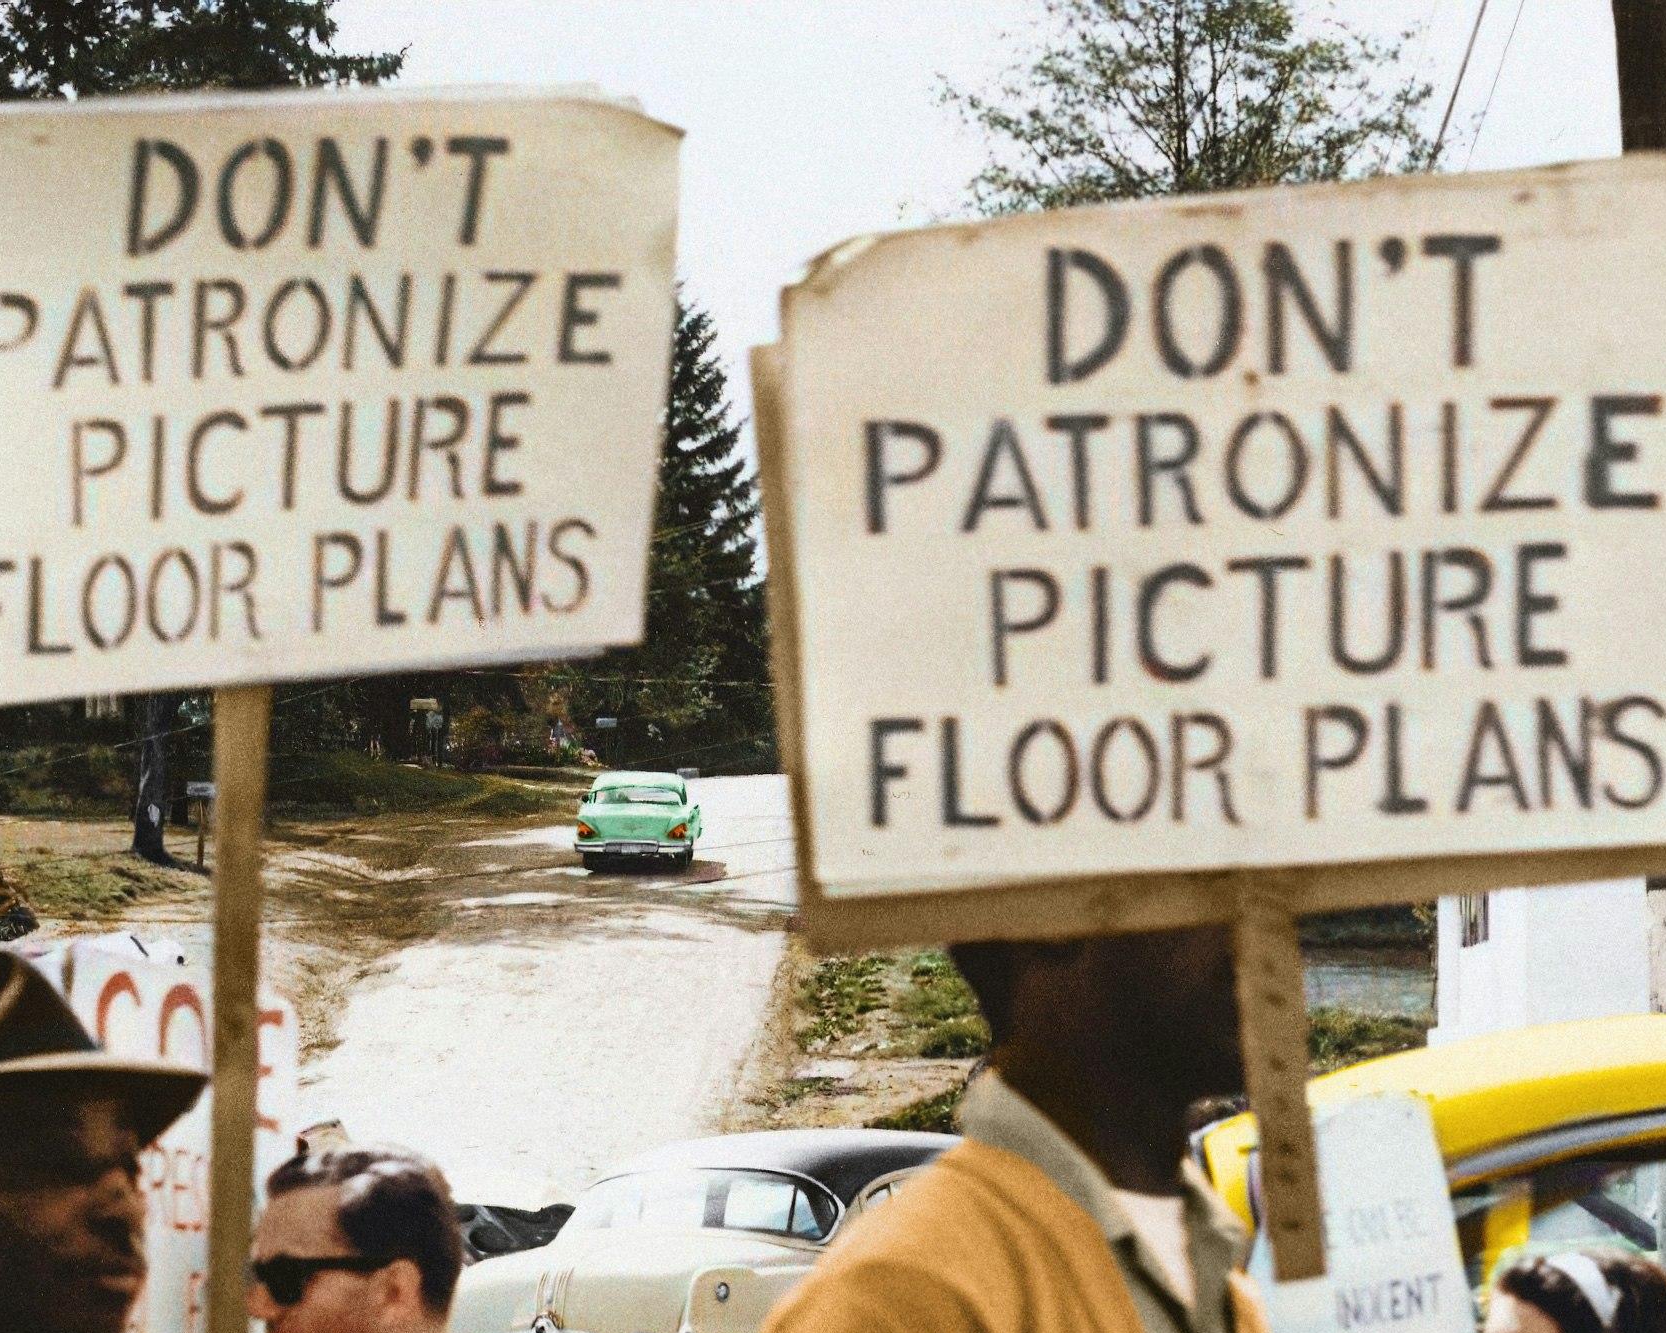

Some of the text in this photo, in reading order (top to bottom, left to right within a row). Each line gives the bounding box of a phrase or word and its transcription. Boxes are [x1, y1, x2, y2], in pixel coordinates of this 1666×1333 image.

[125, 135, 510, 257] DON'T
[1044, 233, 1500, 385] DON'T
[69, 392, 532, 528] PICTURE
[862, 393, 1665, 534] PATRONIZE
[309, 518, 597, 634] PLANS
[990, 541, 1569, 687] PICTURE
[869, 708, 1241, 829] FLOOR
